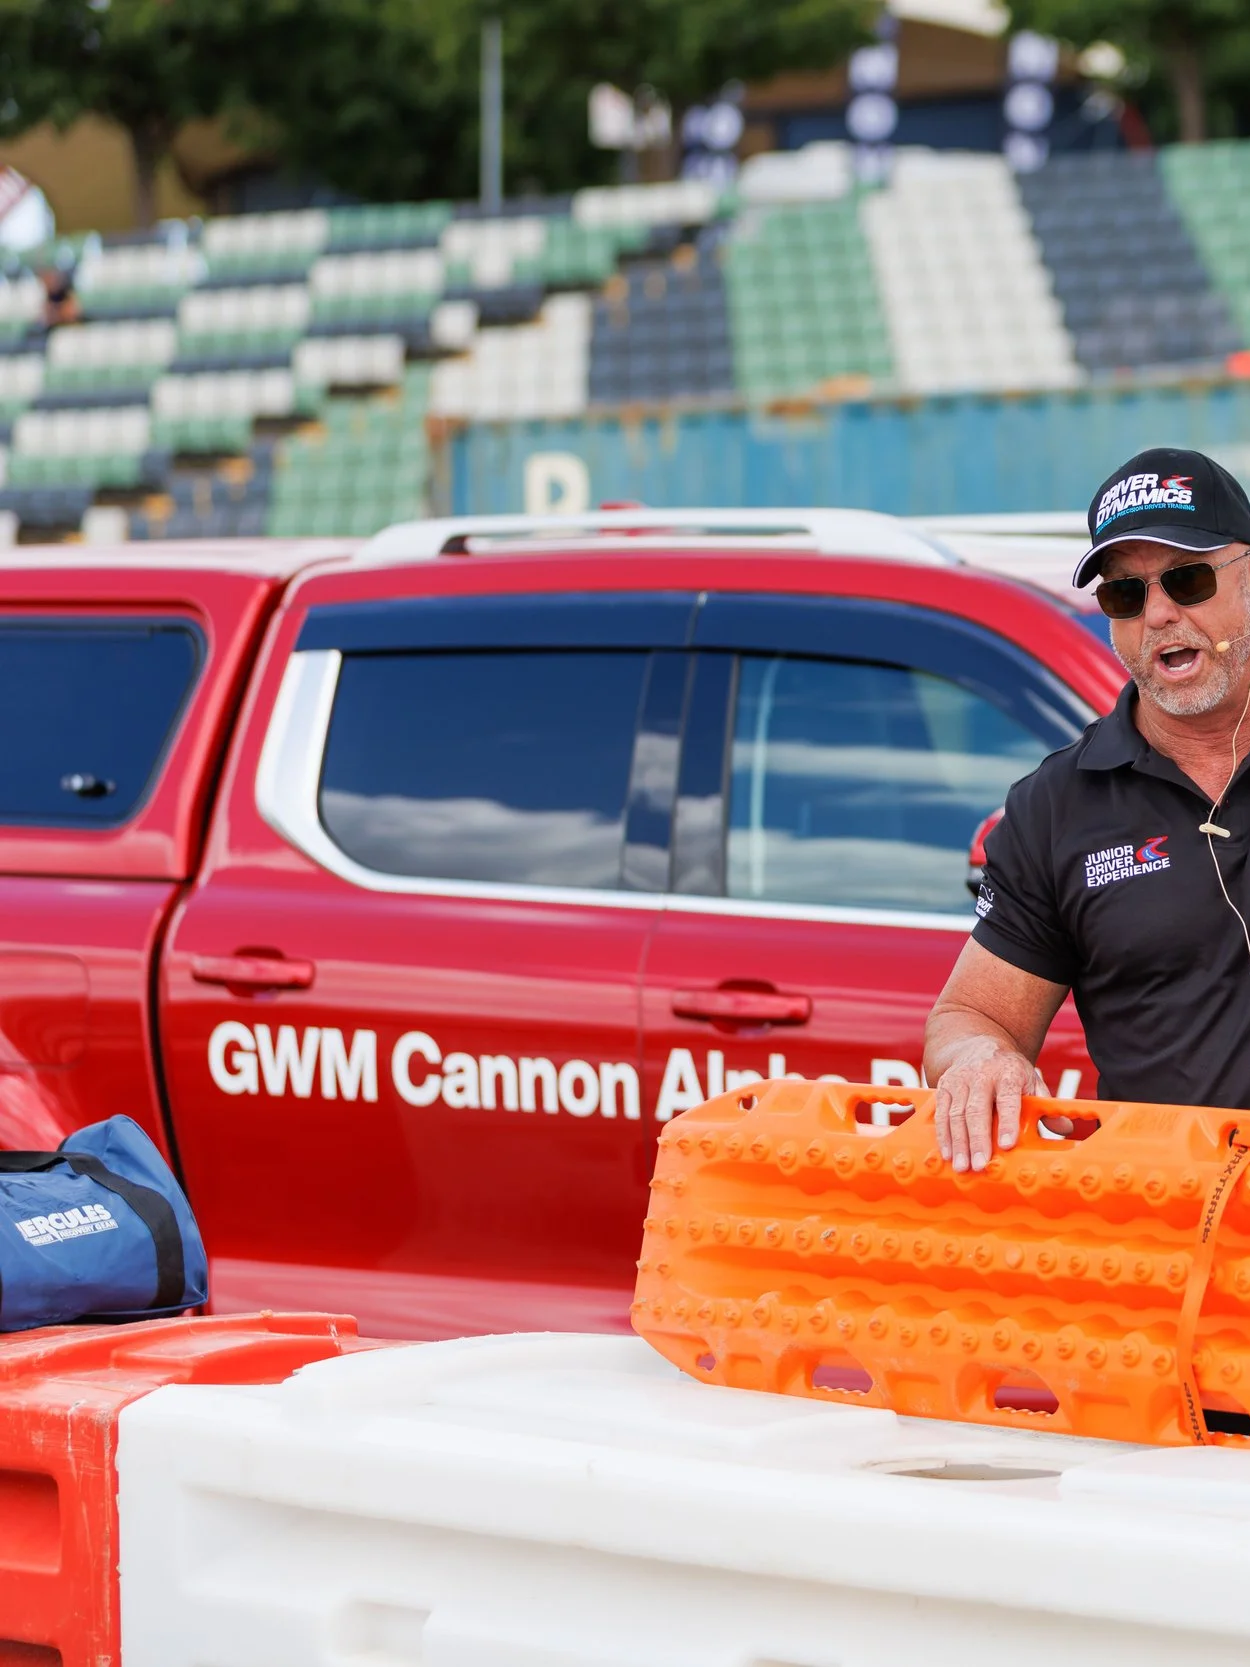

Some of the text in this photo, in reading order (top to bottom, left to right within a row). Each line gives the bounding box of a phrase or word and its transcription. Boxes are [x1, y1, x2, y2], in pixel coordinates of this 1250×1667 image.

[1098, 473, 1158, 511] DRIVER
[1167, 502, 1196, 512] TRAINING
[1096, 488, 1193, 529] DYNAMICS
[1085, 845, 1133, 866] JUNIOR
[1086, 856, 1134, 877] DRIVER
[1087, 857, 1171, 887] EXPERIENCE
[207, 1020, 379, 1103] GWM
[390, 1030, 641, 1120] Cannon
